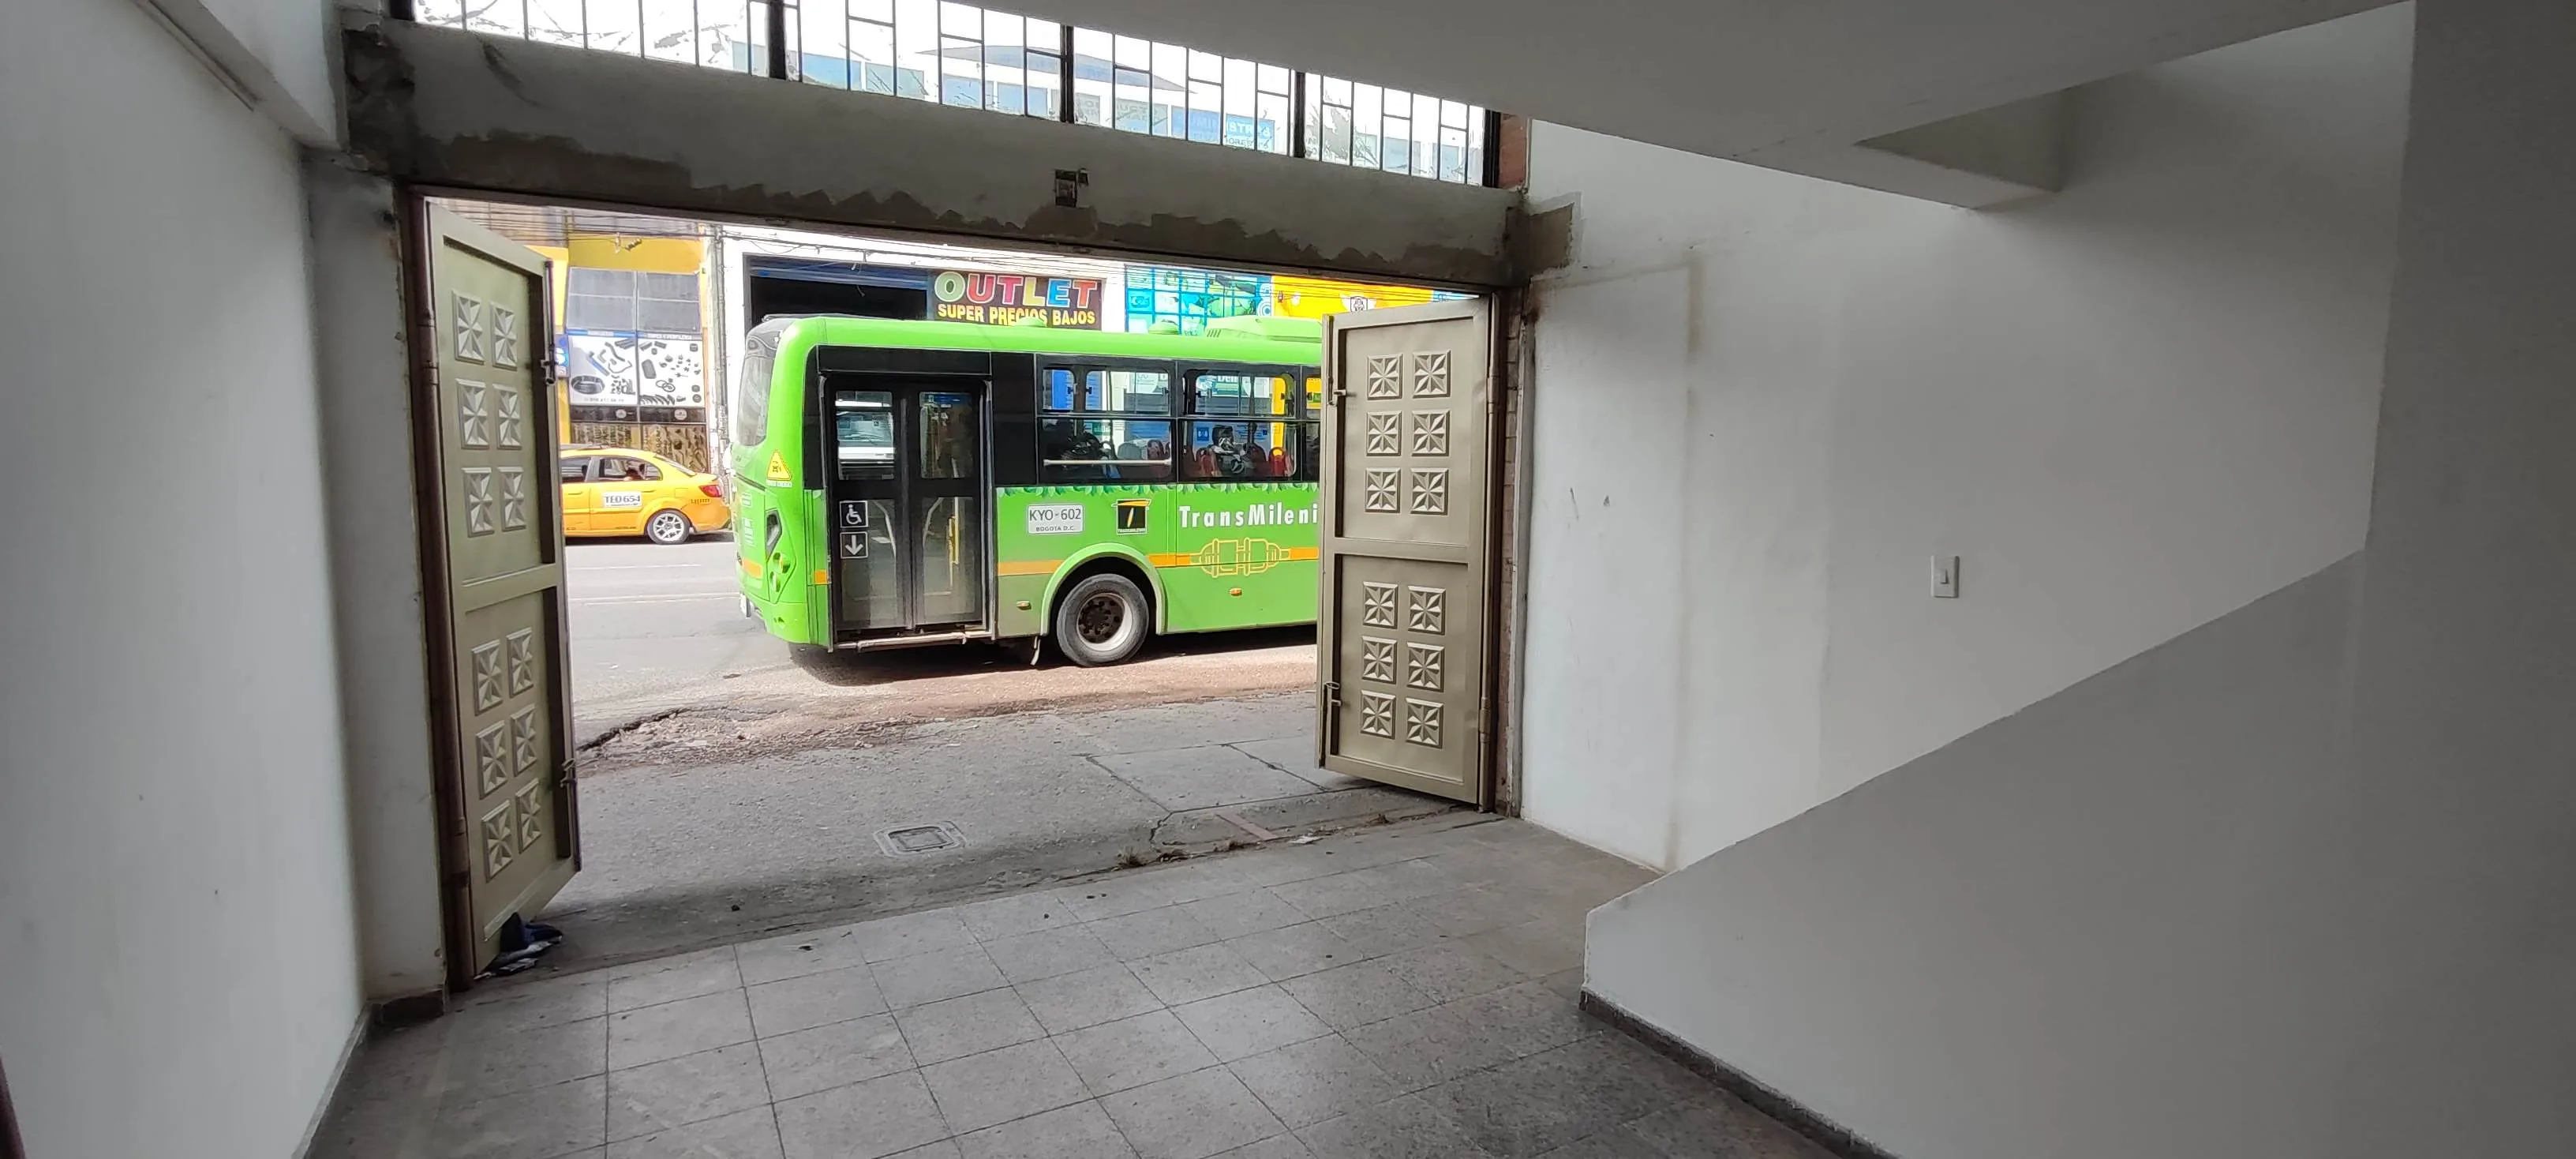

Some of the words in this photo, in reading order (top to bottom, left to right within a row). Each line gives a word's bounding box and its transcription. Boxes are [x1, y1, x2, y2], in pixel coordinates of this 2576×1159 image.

[934, 271, 1098, 309] OUTLET
[938, 303, 985, 323] SUPER
[1052, 309, 1096, 326] BAJOS
[1178, 502, 1318, 528] TransMileni
